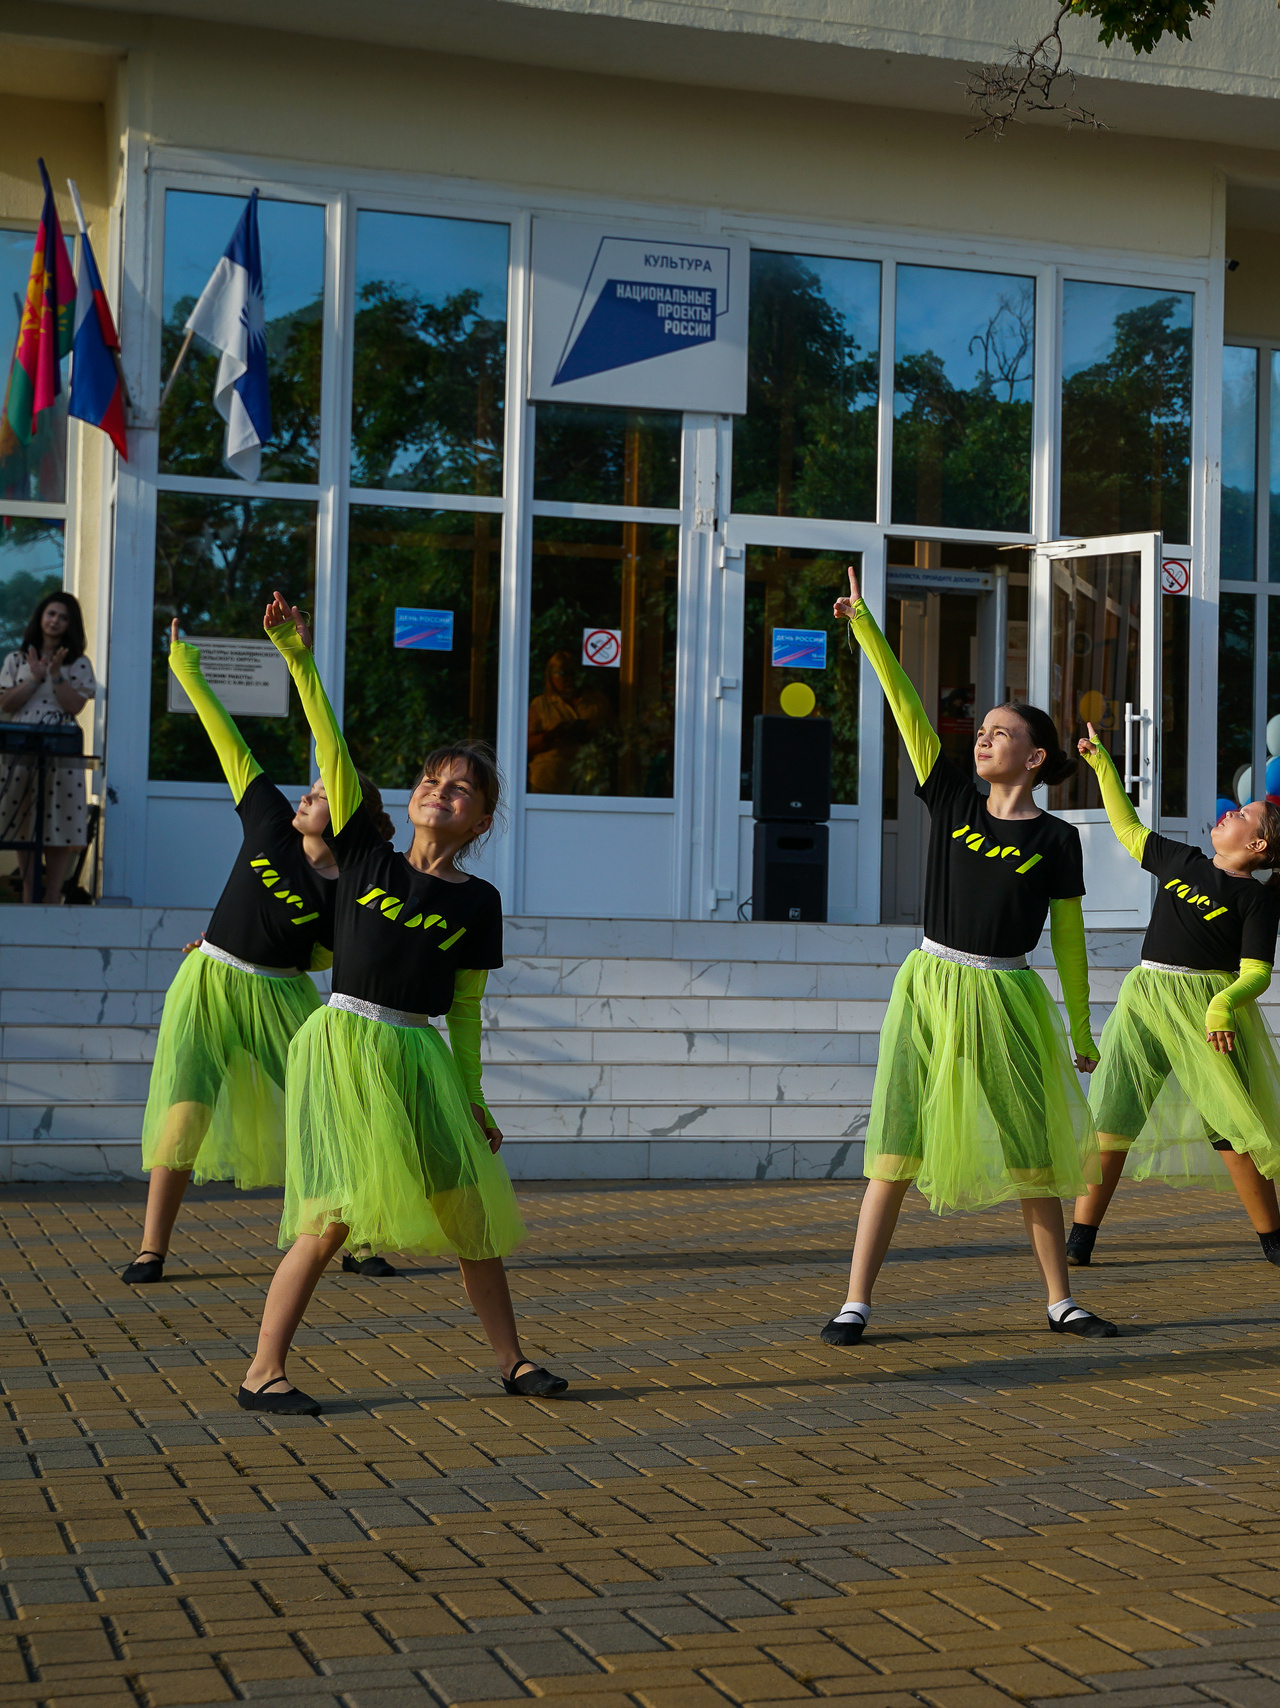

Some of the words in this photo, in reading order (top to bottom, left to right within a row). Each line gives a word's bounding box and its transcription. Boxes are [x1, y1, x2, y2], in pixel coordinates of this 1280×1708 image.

[644, 254, 712, 273] КУЛЬТУРА
[616, 283, 712, 306] НАЦИОНАЛЬНЫЕ
[657, 303, 712, 321] ПРОЕКТЫ
[664, 319, 711, 337] РОССИИ
